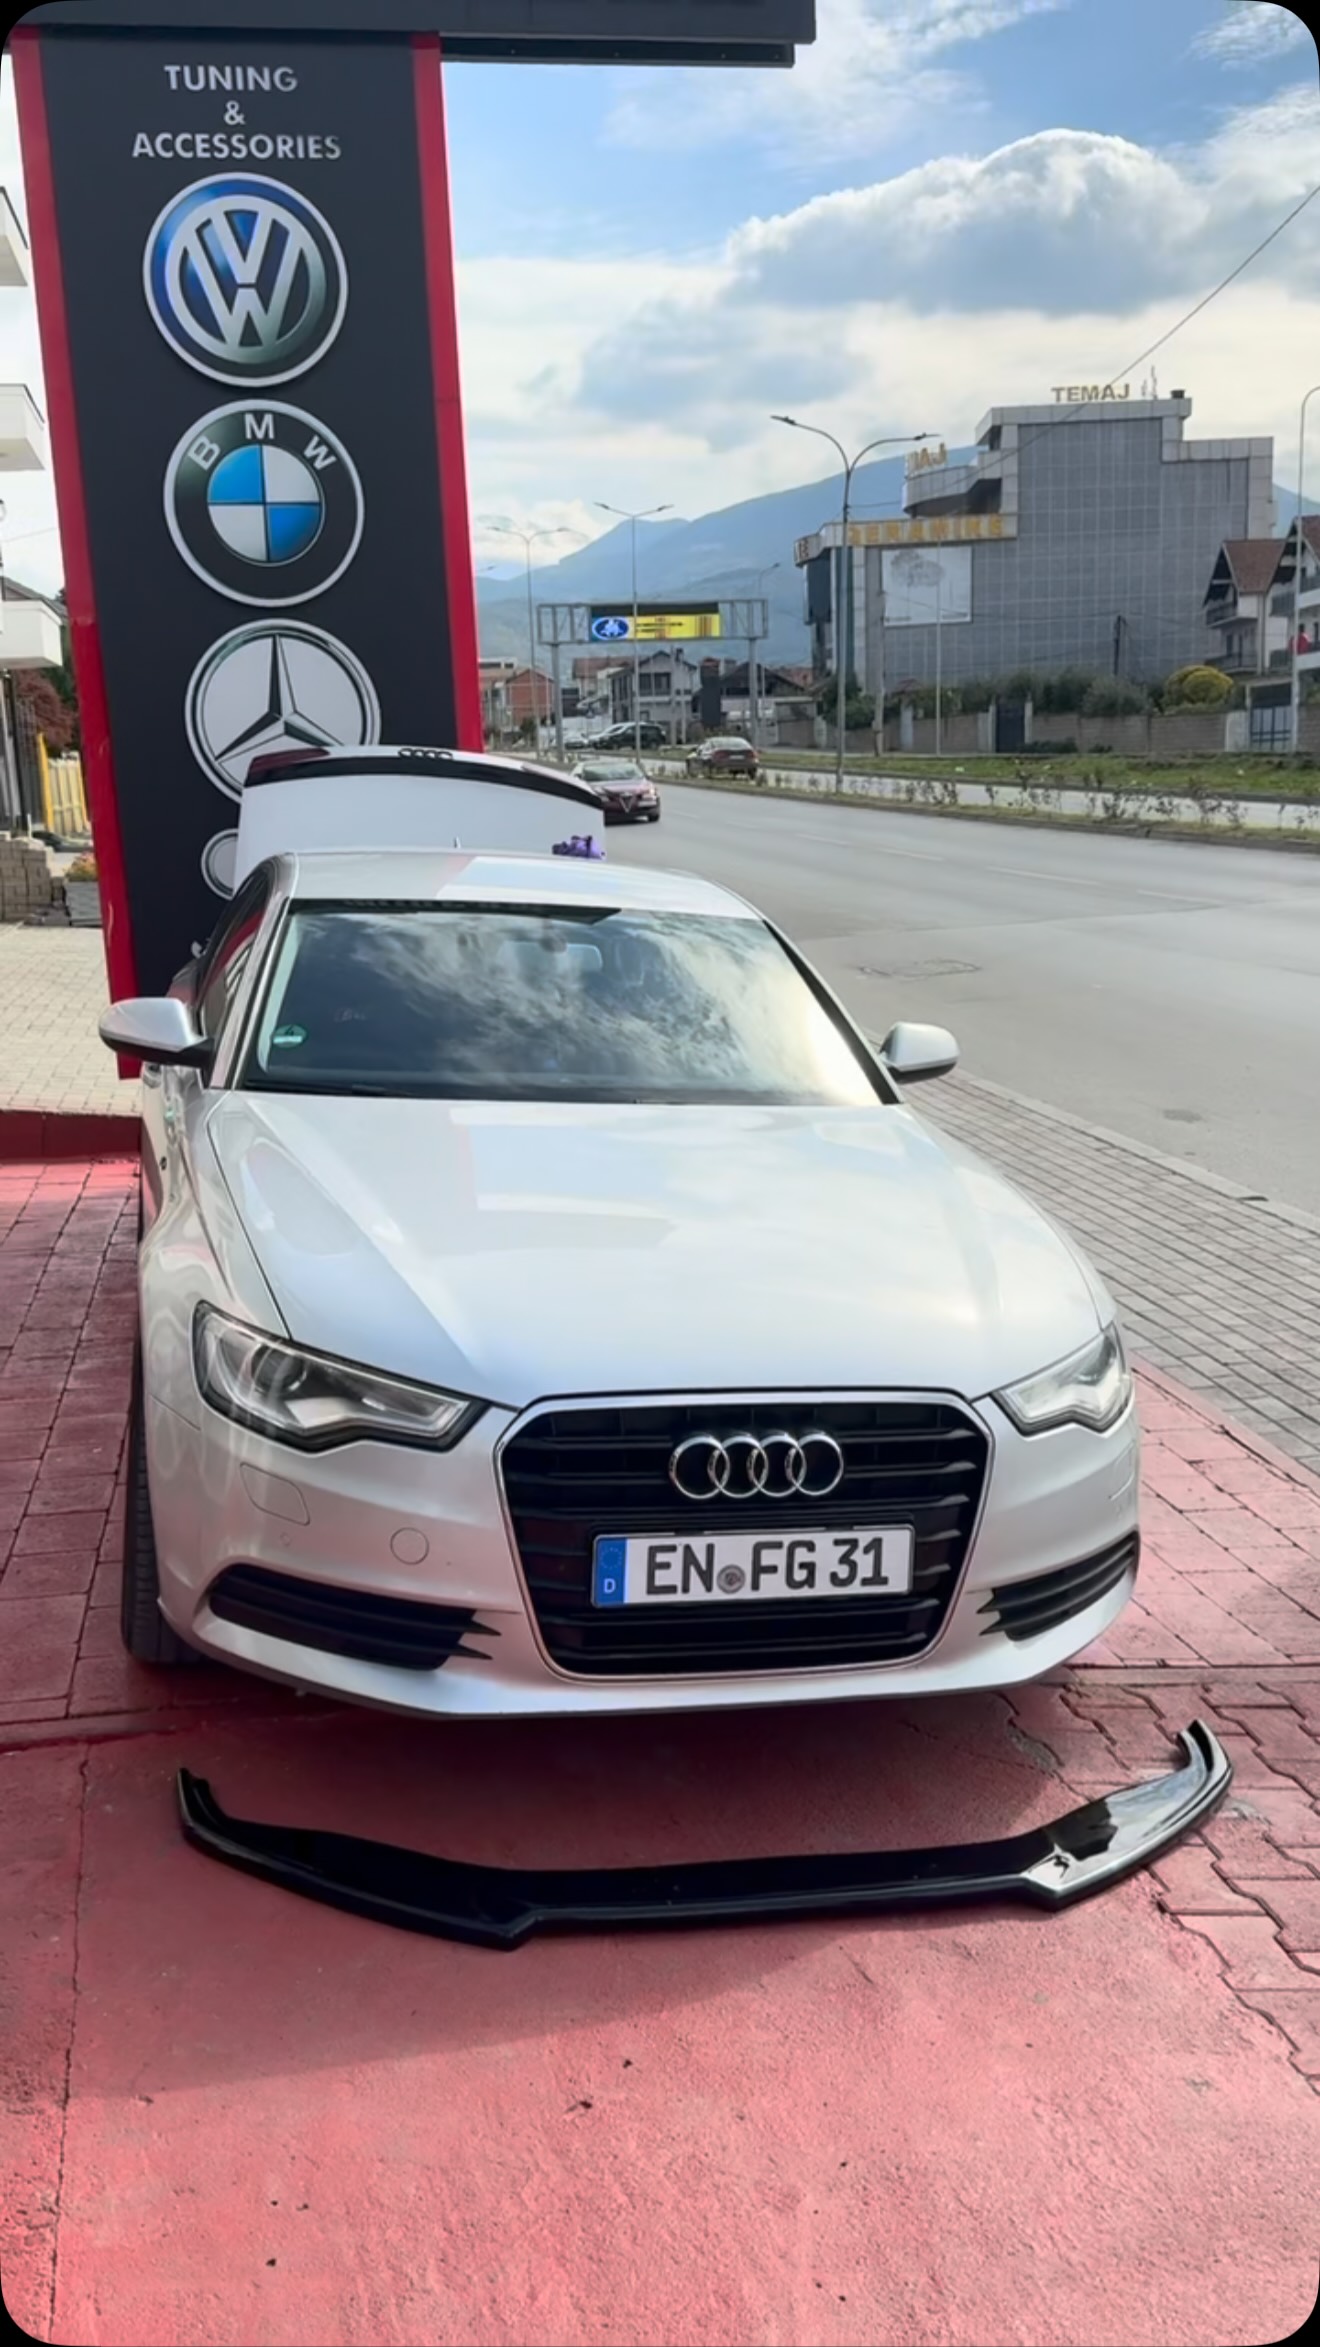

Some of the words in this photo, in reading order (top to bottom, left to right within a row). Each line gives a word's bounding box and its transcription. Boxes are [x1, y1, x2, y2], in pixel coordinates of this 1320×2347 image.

[163, 64, 299, 93] TUNING
[223, 100, 246, 126] &
[131, 132, 342, 160] ACCESSORIES
[1051, 383, 1130, 402] TEMAJ
[186, 412, 337, 472] BMW
[645, 1542, 716, 1596] EN
[750, 1539, 817, 1592] FG
[829, 1536, 890, 1588] 31
[603, 1578, 616, 1595] D
